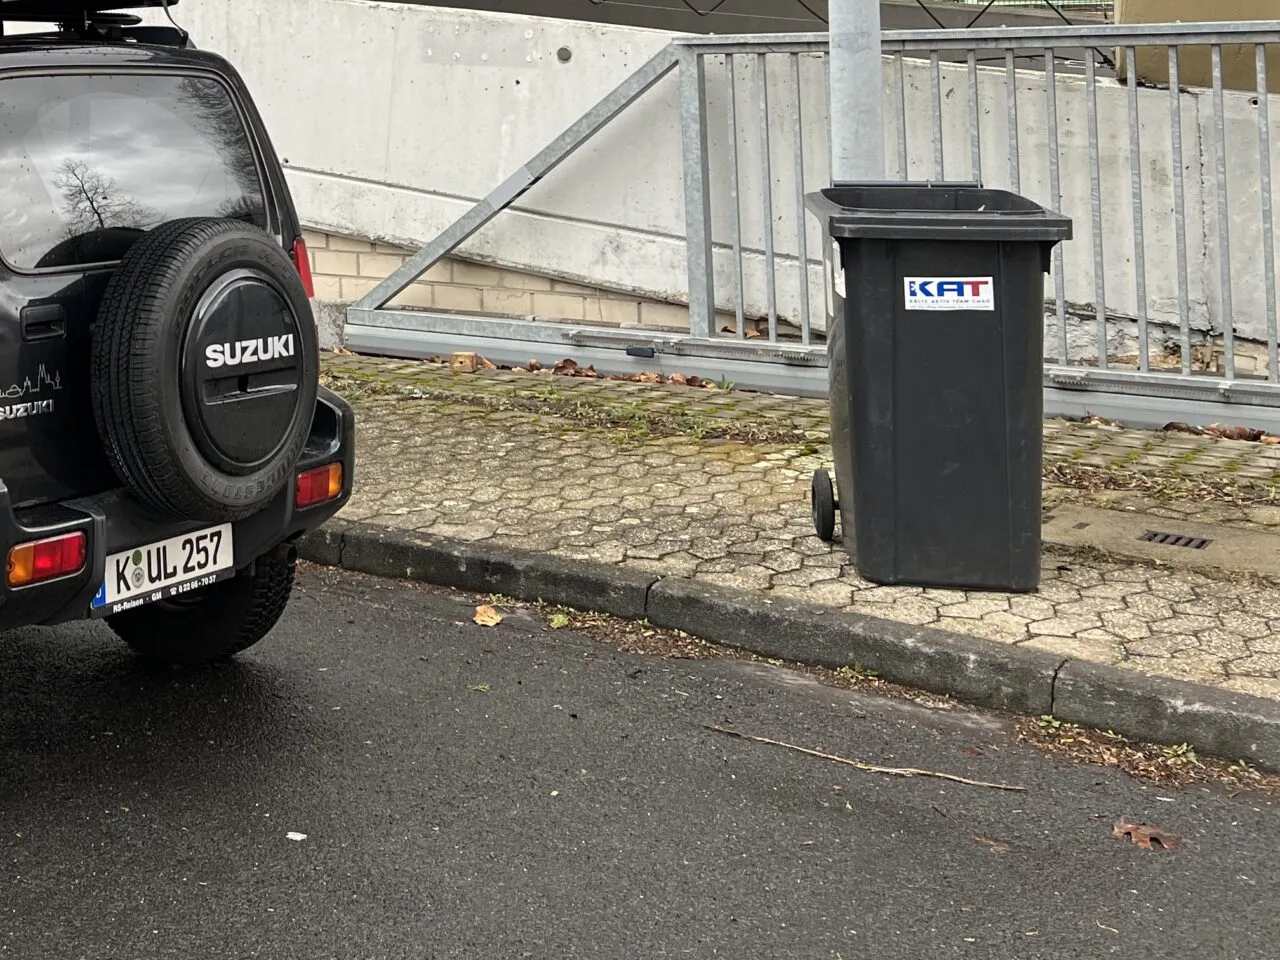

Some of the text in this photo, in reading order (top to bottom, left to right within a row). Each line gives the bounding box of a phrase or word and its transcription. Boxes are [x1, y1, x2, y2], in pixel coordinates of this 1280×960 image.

[908, 280, 989, 297] KAT
[205, 333, 295, 369] SUZUKI
[116, 555, 131, 594] K
[182, 530, 222, 573] 257
